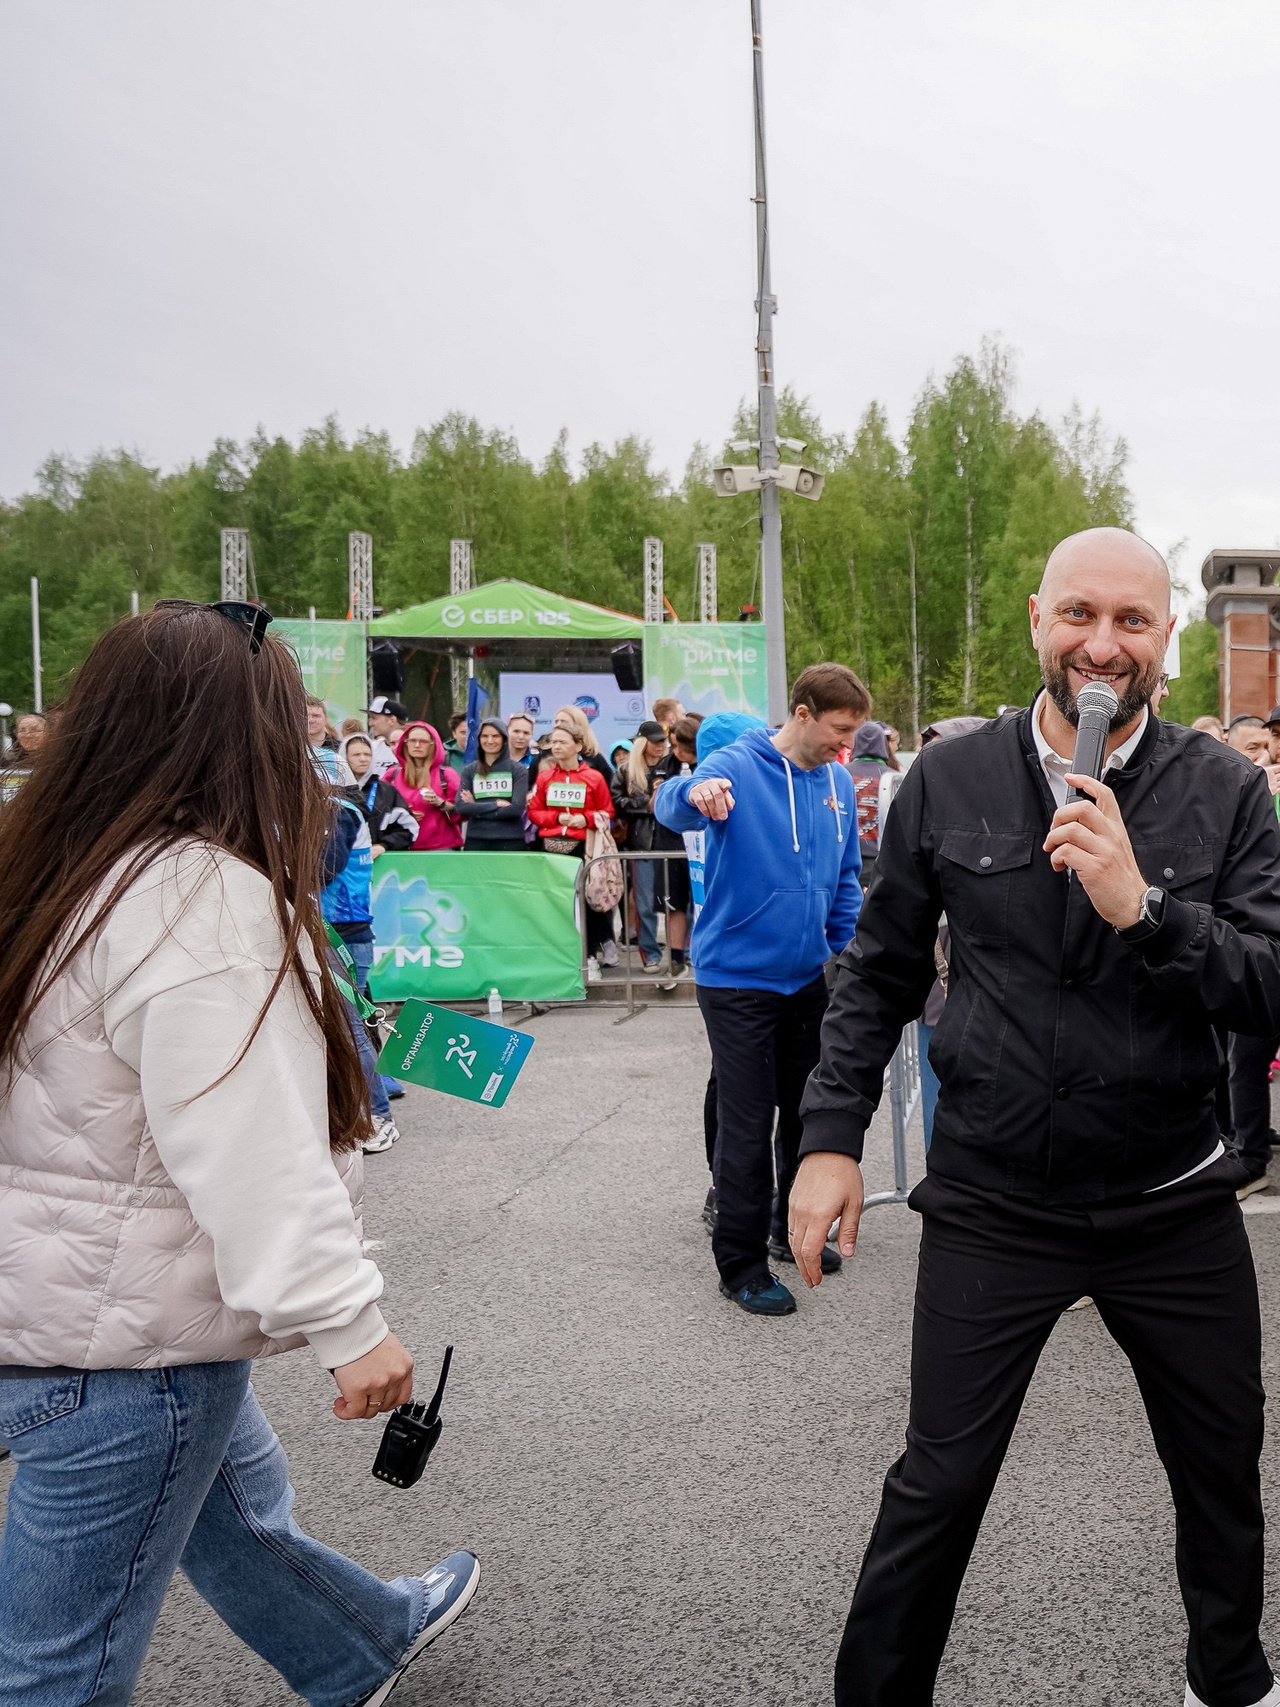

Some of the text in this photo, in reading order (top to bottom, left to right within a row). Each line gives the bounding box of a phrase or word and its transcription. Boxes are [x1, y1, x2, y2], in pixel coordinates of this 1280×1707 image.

[469, 608, 523, 625] СБЕР
[684, 646, 758, 668] ритме
[479, 780, 508, 790] 1510
[553, 790, 581, 800] 1590
[401, 1012, 435, 1071] ОРГАНИЗАТОР
